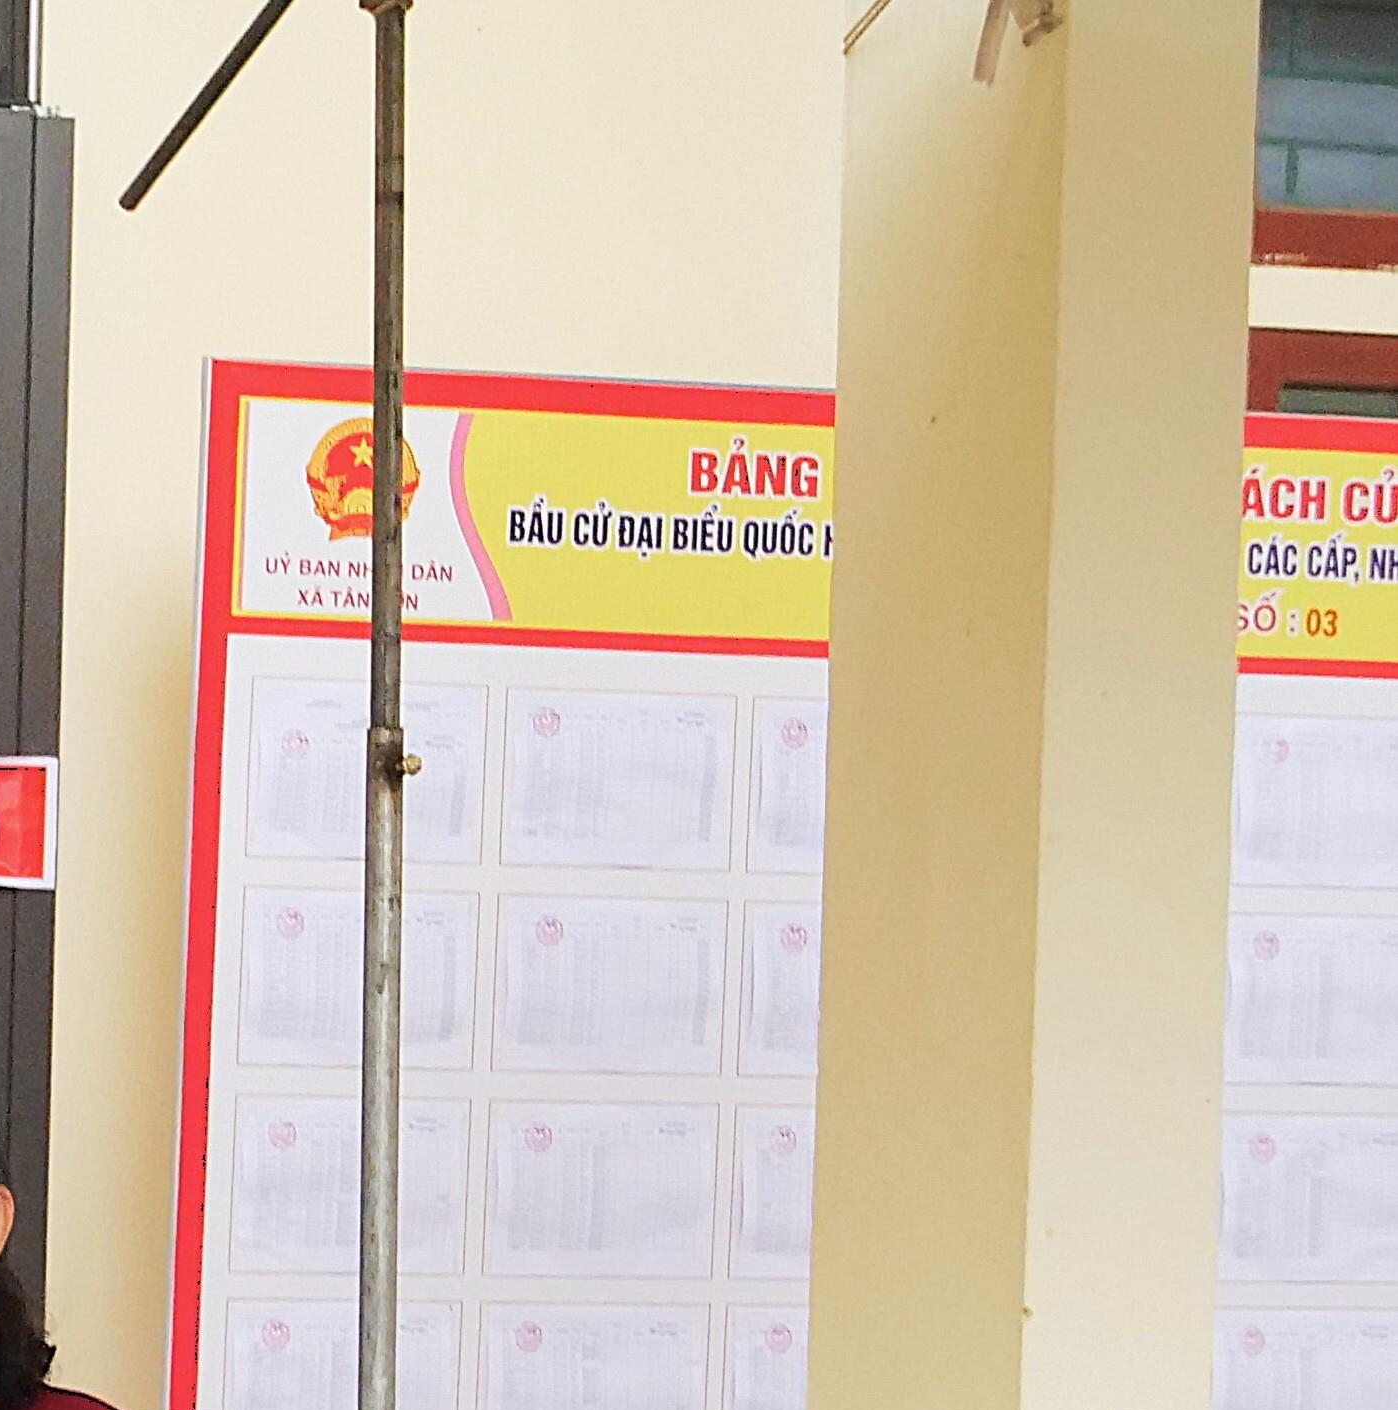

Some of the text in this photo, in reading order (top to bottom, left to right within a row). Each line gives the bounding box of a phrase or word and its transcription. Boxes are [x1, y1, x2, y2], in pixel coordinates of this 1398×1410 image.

[691, 438, 818, 498] BẢNG
[510, 498, 563, 544] BẦU
[574, 501, 612, 546] CỬ
[618, 515, 662, 557] ĐẠI
[672, 504, 733, 551] BIỂU
[744, 509, 813, 558] QUỐC
[1247, 535, 1297, 576] CÁC
[1308, 532, 1359, 582] CẤP,
[299, 558, 340, 577] BAN
[412, 560, 452, 582] DÂN
[331, 587, 369, 609] TÂN
[1306, 608, 1338, 637] 03
